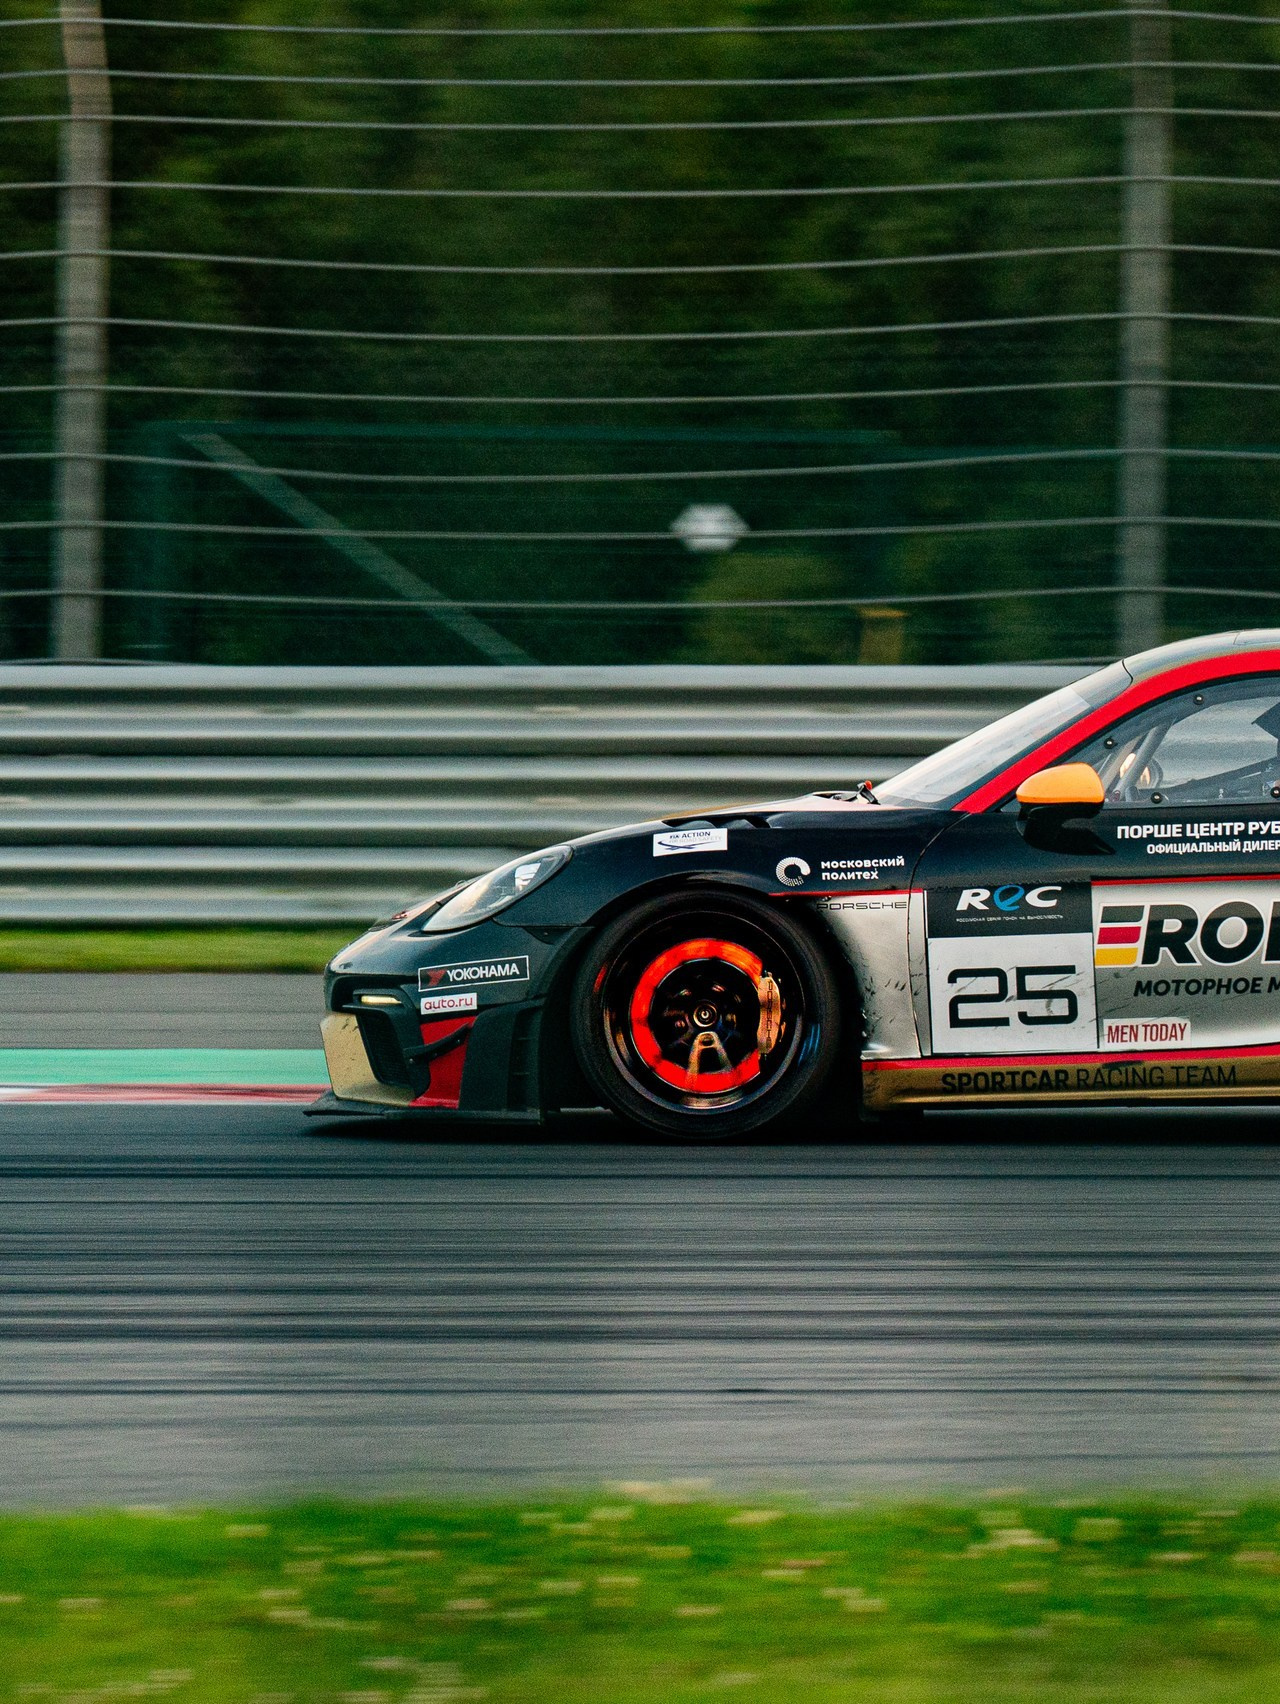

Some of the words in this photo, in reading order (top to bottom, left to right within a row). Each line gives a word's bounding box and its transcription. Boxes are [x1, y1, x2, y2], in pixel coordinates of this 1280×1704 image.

[681, 831, 711, 839] ACTION
[1117, 825, 1182, 839] ПОРШЕ
[1186, 822, 1245, 838] ЦЕНТР
[1147, 839, 1241, 855] ОФИЦИАЛЬНЫЙ
[817, 901, 907, 910] PORSCHE
[447, 963, 520, 982] YOKOHAMA
[1133, 977, 1263, 997] МОТОРНОЕ
[424, 997, 473, 1010] auto.ru
[948, 965, 1079, 1029] 25
[1107, 1024, 1139, 1043] MEN
[1141, 1023, 1187, 1042] TODAY
[941, 1069, 1069, 1094] SPORTCAR
[1076, 1066, 1165, 1089] RACING
[1171, 1065, 1236, 1087] TEAM
